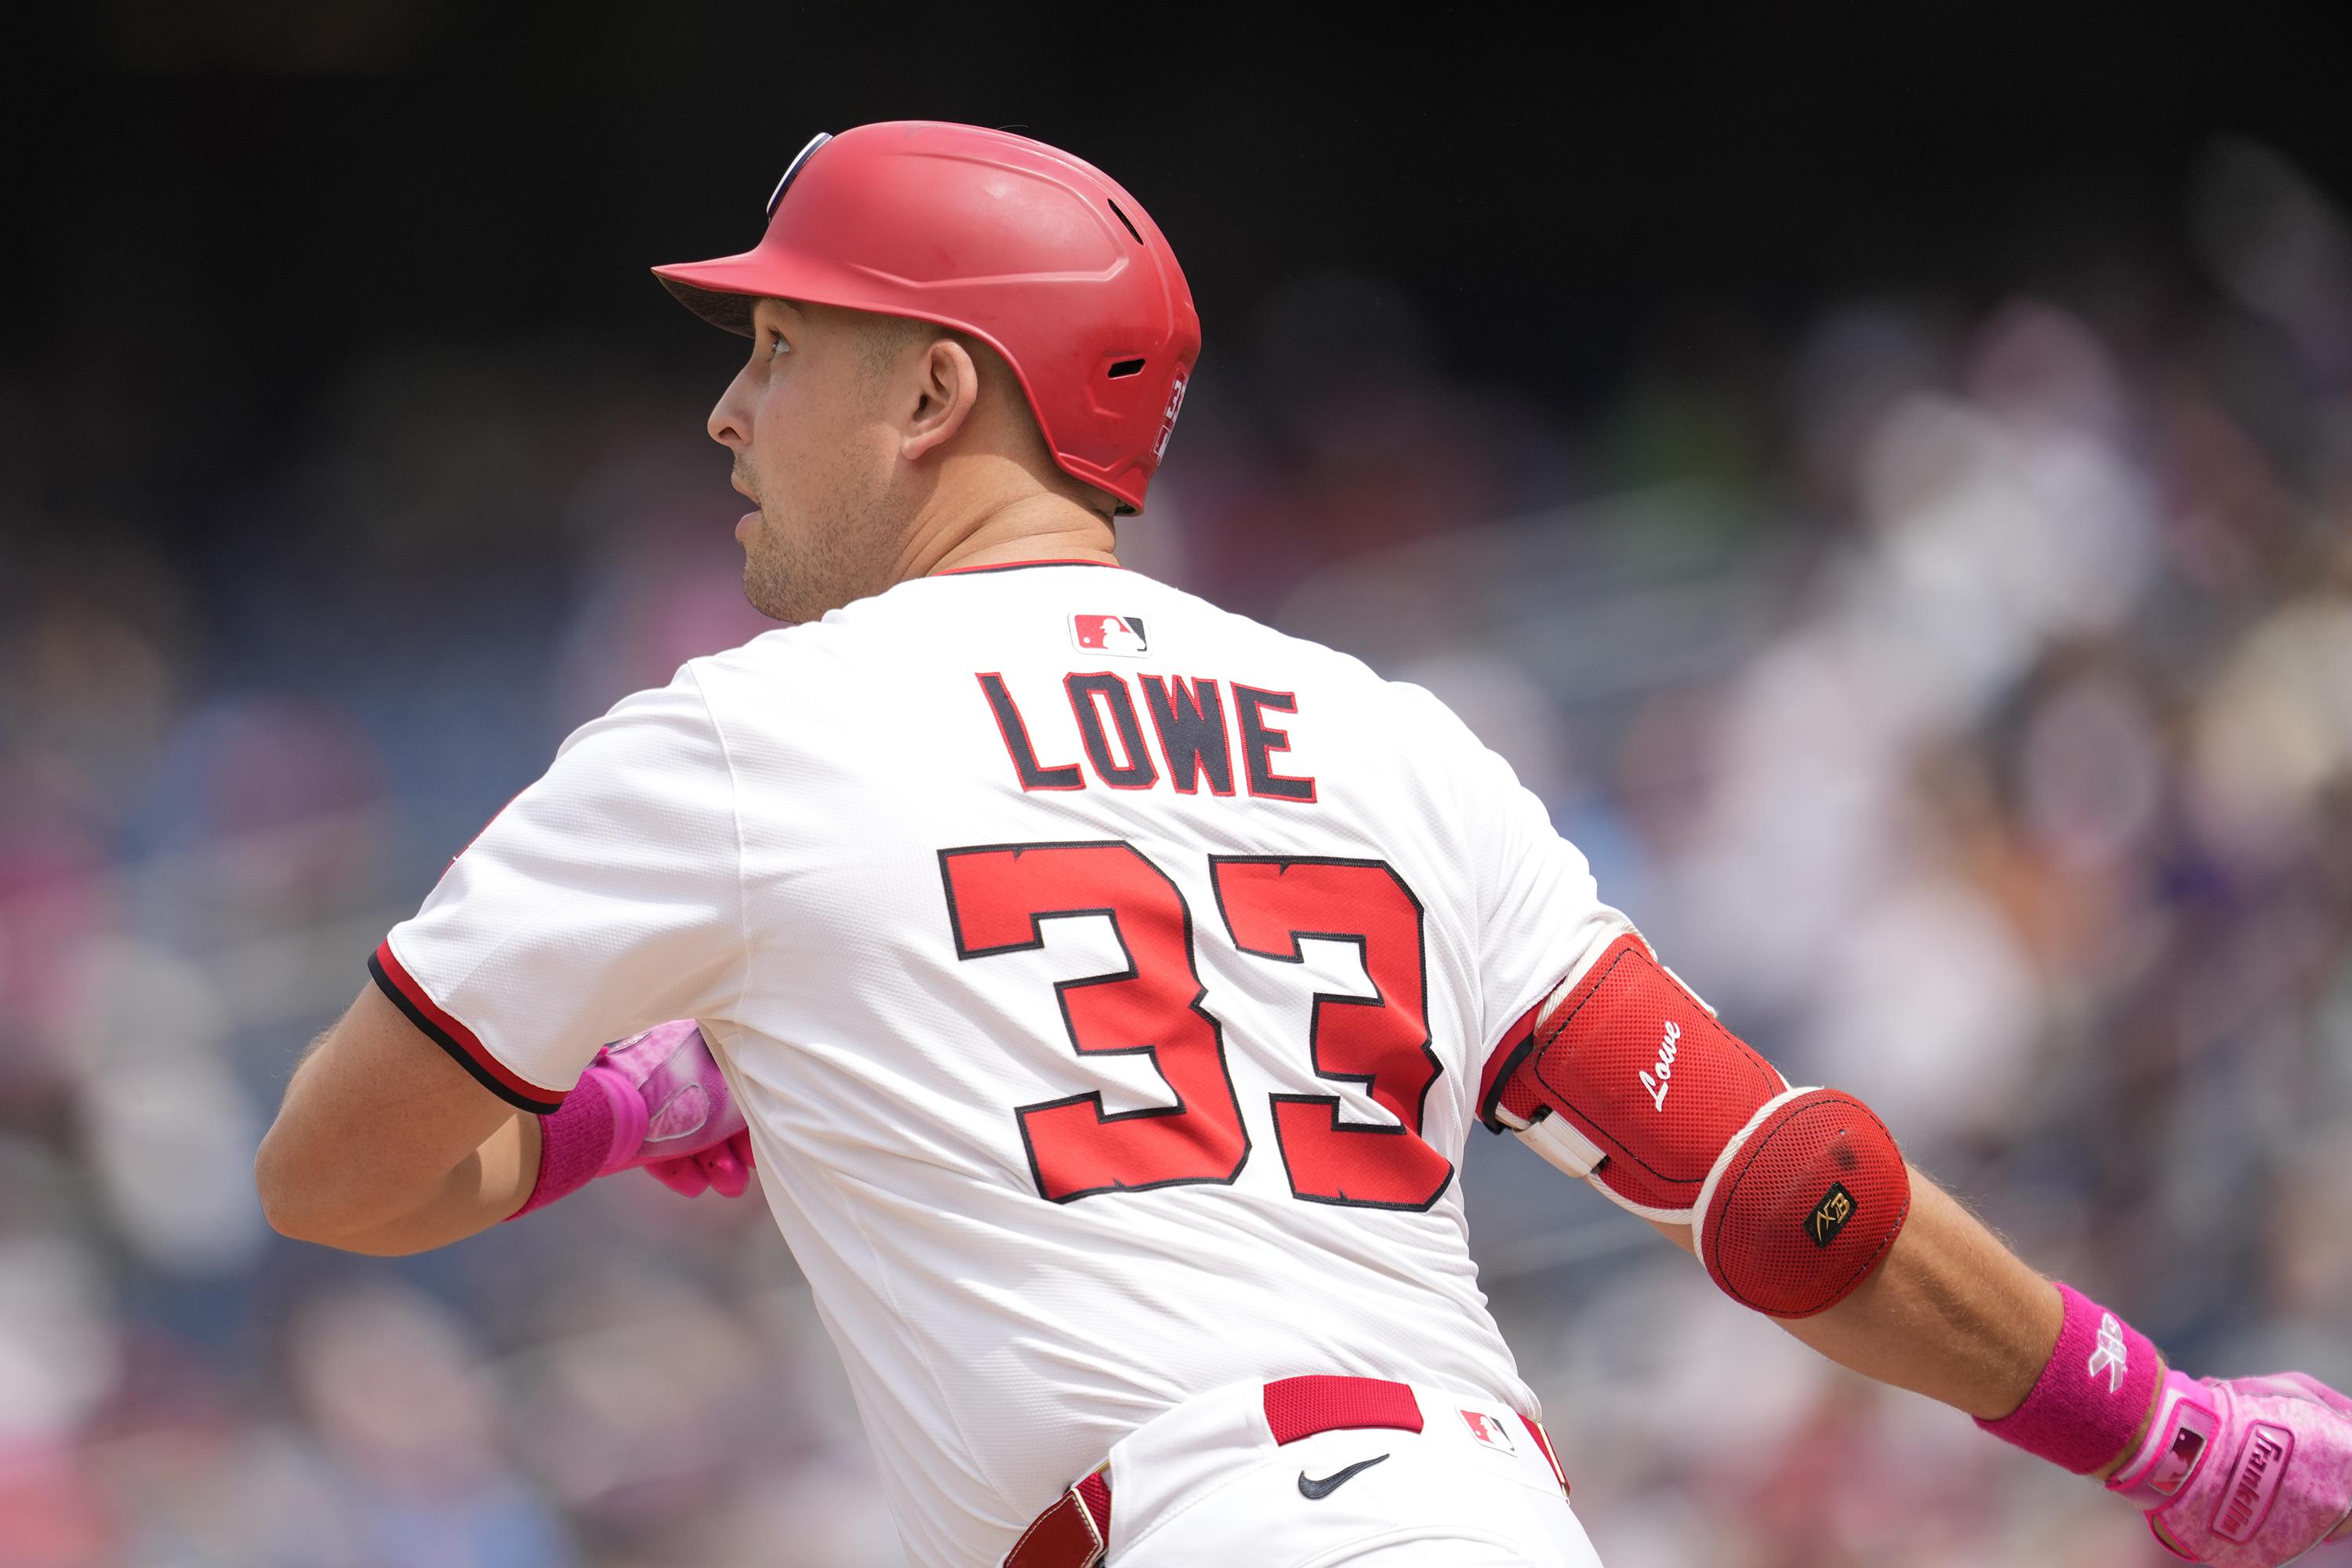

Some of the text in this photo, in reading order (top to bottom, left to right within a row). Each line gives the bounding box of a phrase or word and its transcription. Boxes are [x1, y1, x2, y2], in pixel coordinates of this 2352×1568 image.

[974, 672, 1318, 804] LOWE
[936, 840, 1455, 1212] 33
[1639, 1021, 1681, 1112] Lowe
[2220, 1428, 2283, 1534] Franklin
